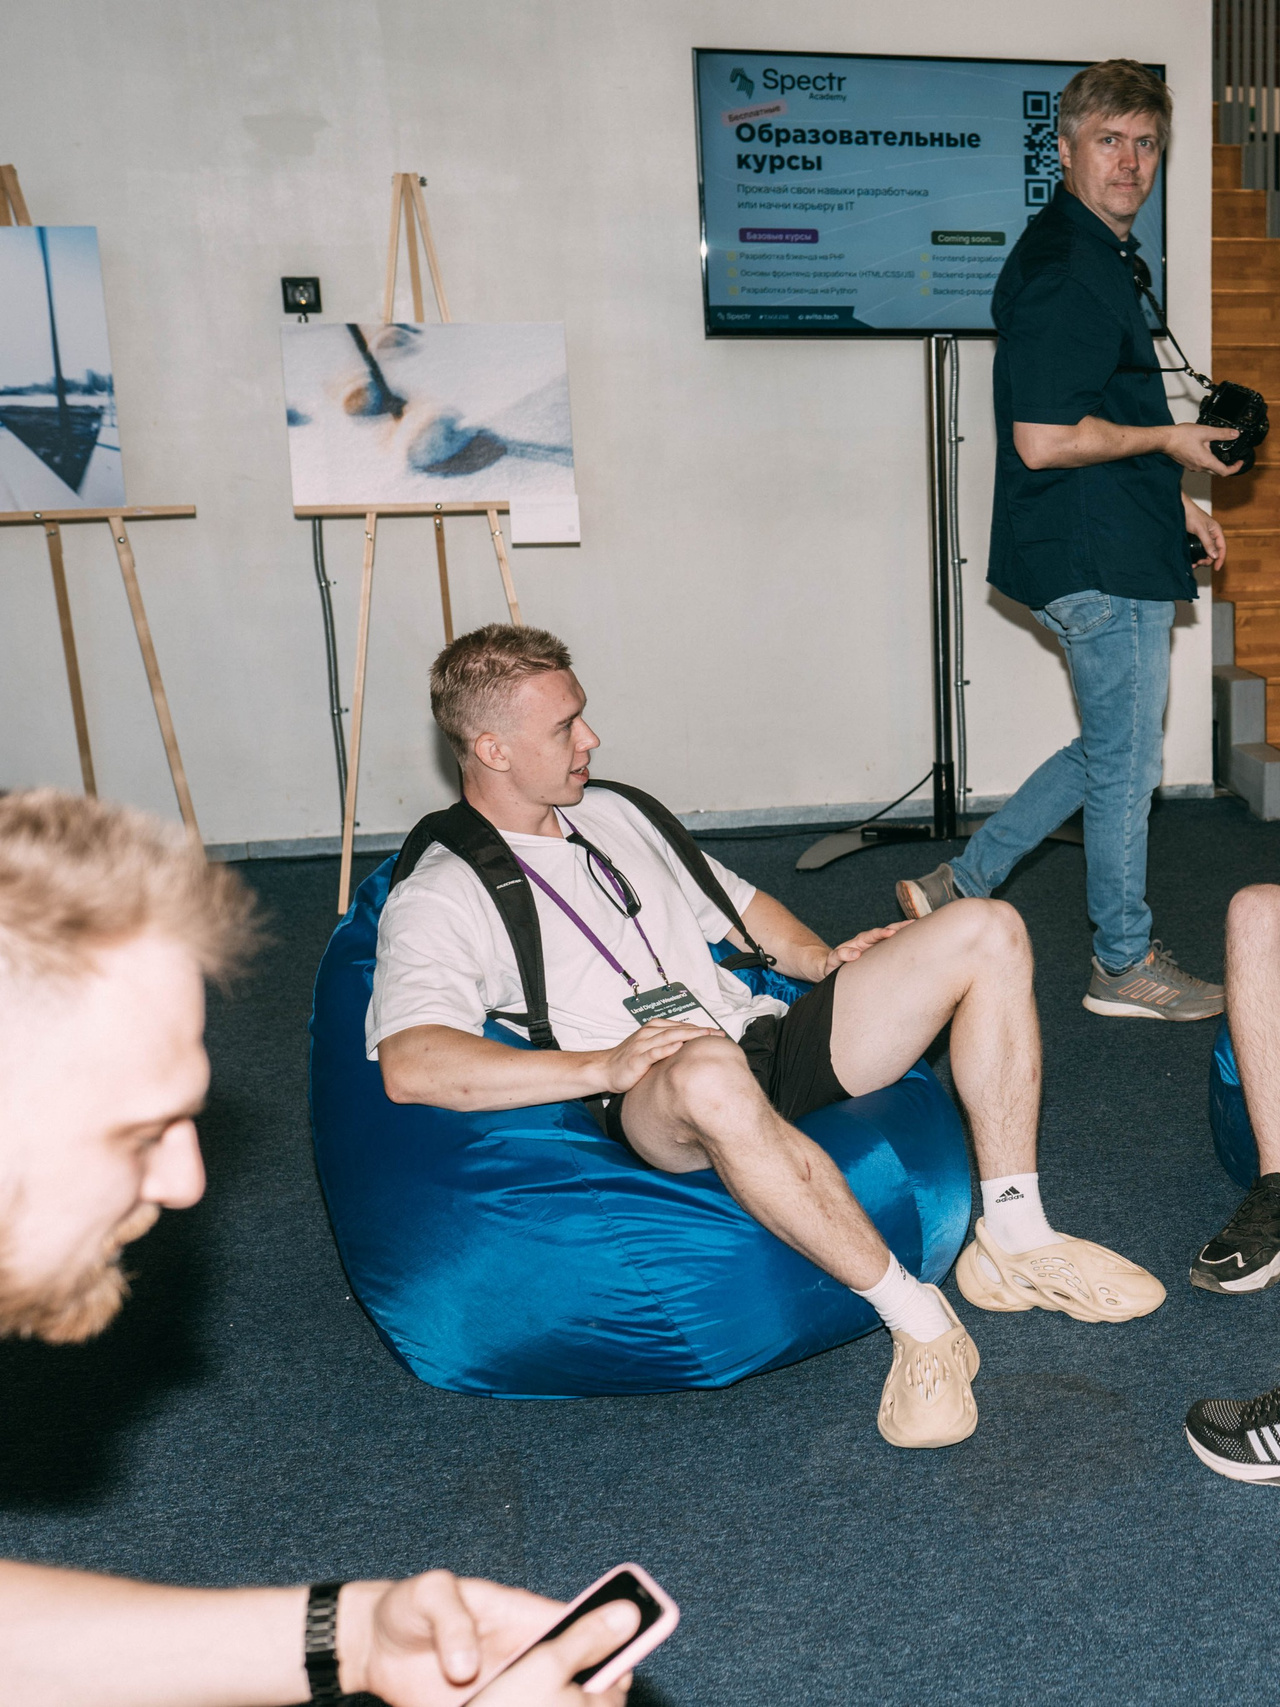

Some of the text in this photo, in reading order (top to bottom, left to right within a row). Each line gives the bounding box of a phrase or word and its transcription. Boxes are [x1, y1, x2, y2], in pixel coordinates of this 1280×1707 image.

[762, 68, 847, 95] Spectr
[809, 92, 847, 102] Academy
[728, 104, 782, 123] Бесплатные
[735, 122, 982, 149] Образовательные
[737, 153, 823, 174] курсы
[737, 183, 929, 198] Прокачай свои навыки разработчика
[738, 201, 758, 209] или
[759, 202, 791, 210] начни
[792, 202, 836, 213] карьеру
[837, 203, 844, 211] в
[785, 233, 813, 243] курсы
[937, 234, 970, 245] Coming
[830, 286, 858, 296] Python
[995, 1193, 1025, 1204] adidas
